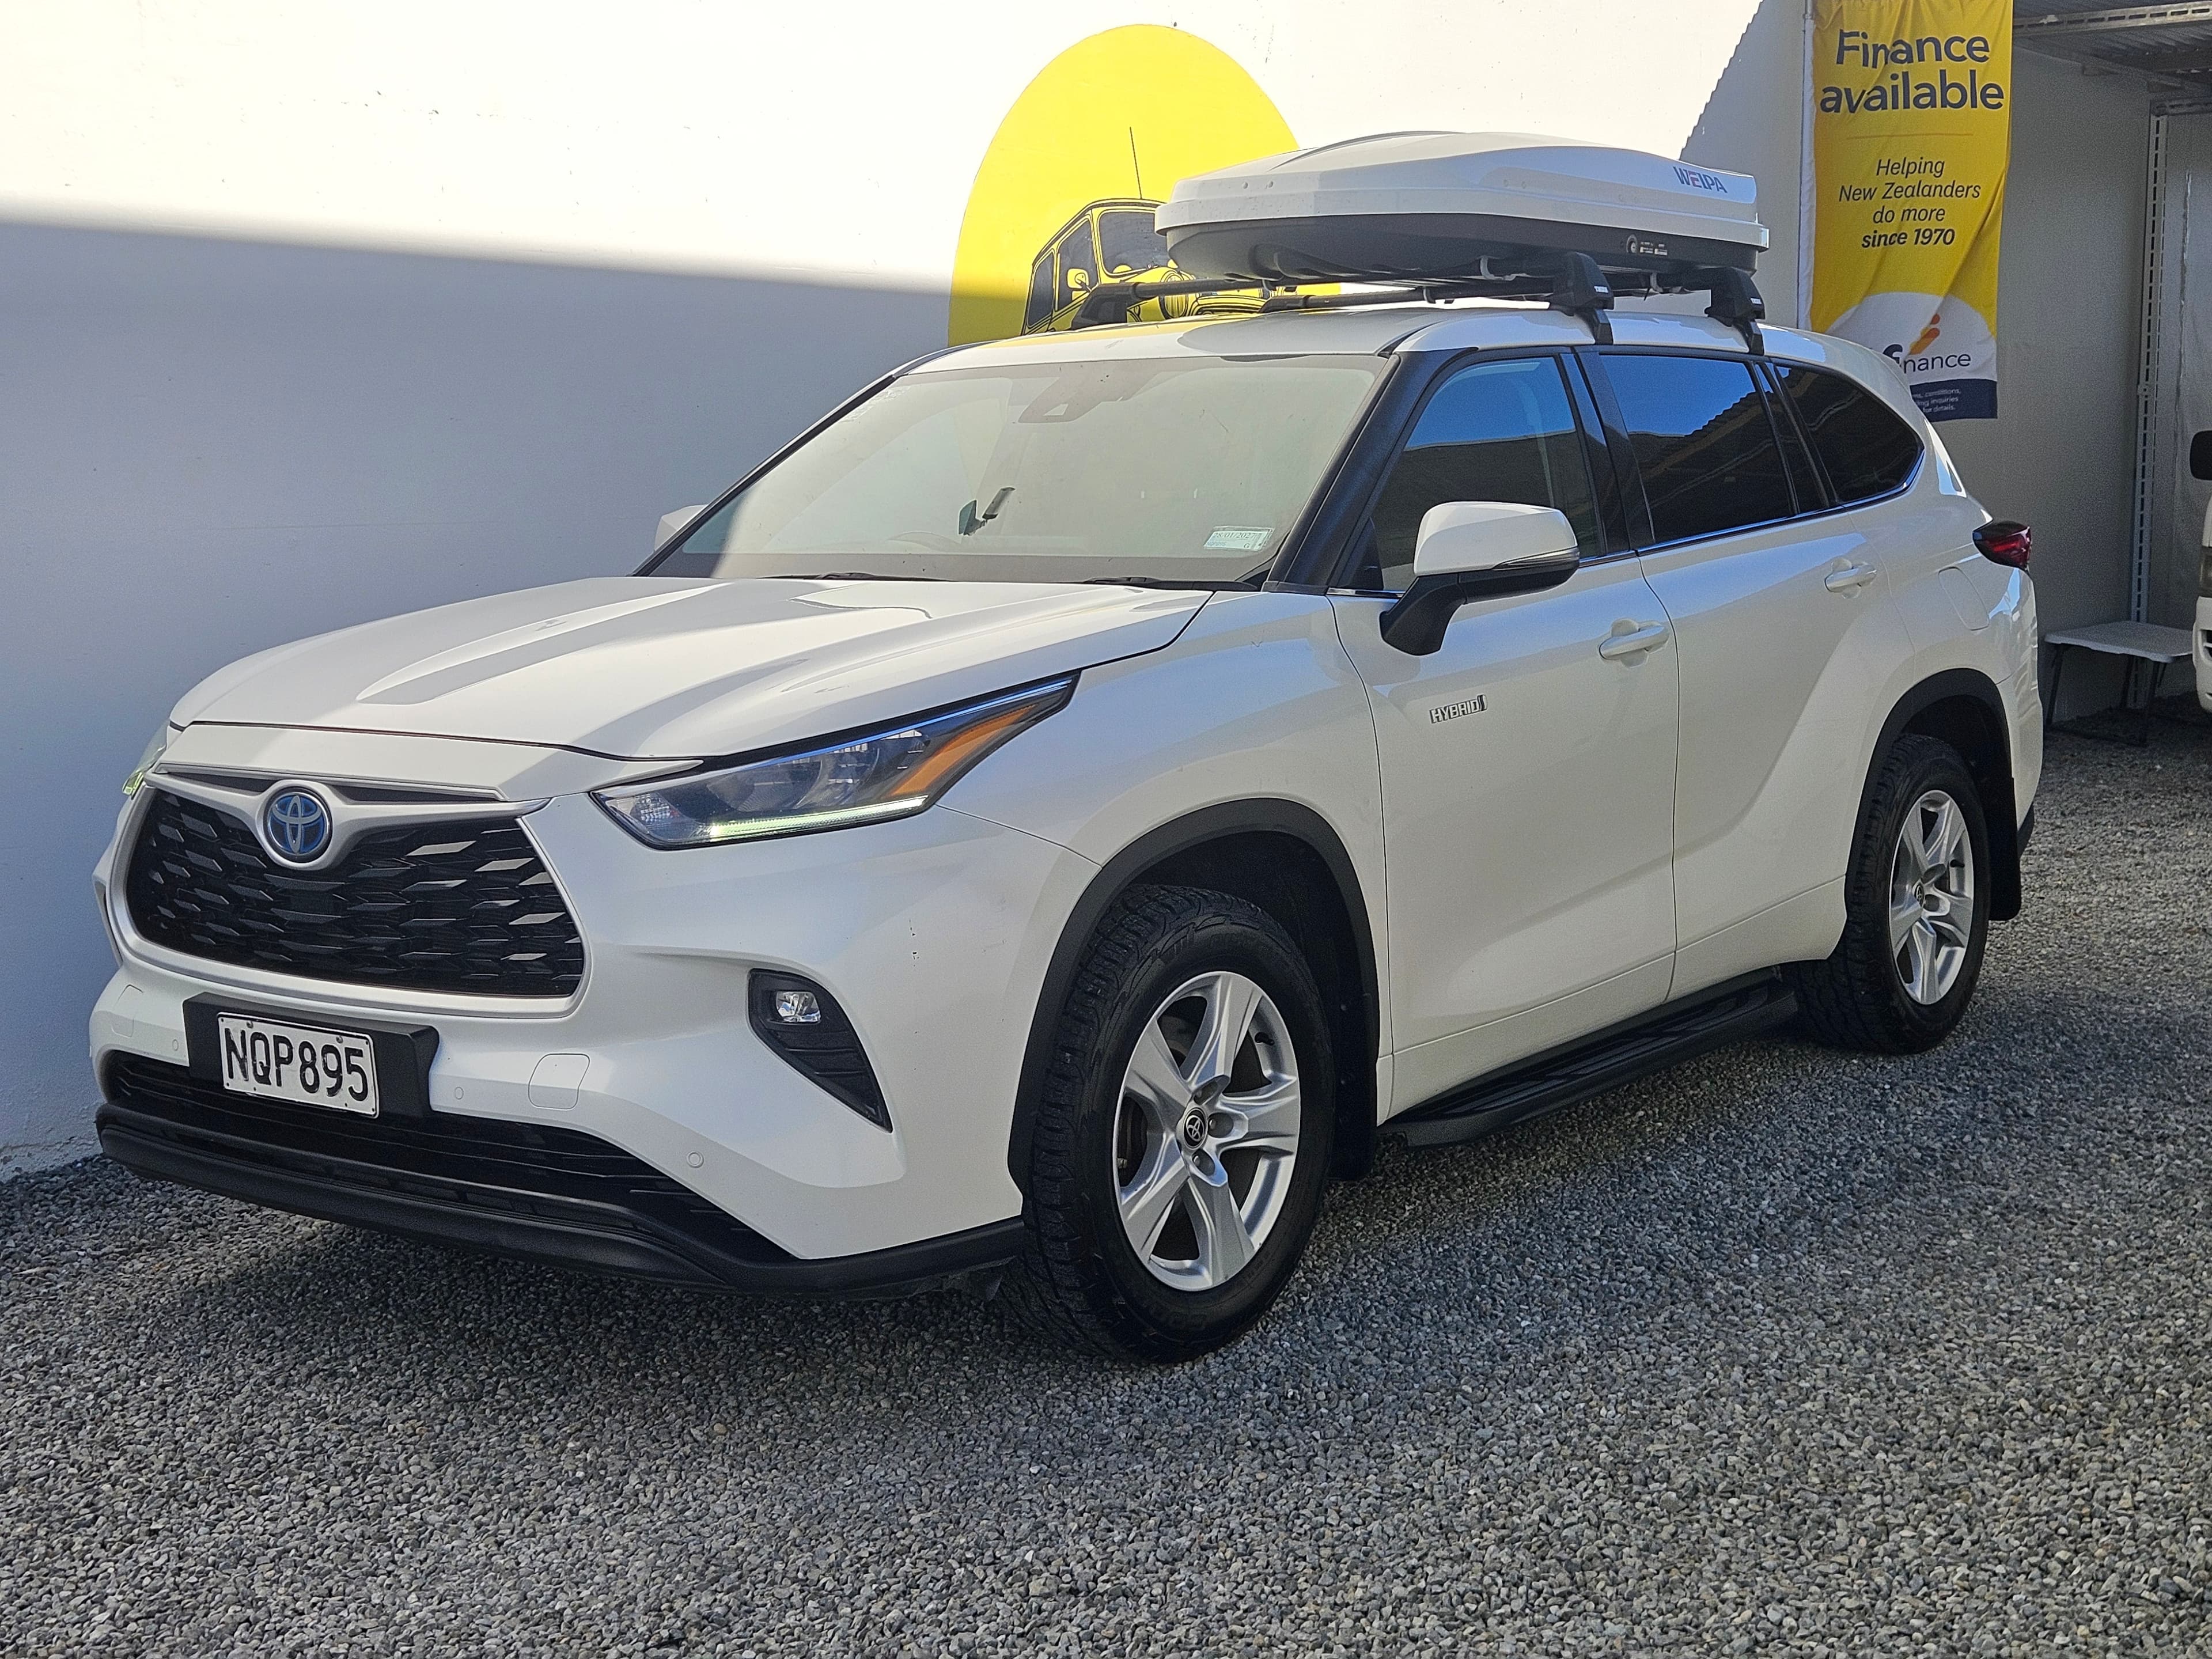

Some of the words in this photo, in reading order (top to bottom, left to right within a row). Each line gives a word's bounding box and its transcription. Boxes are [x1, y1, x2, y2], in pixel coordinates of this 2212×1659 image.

[1836, 29, 1990, 69] Finance
[1820, 69, 2005, 113] available
[1876, 157, 1945, 178] Helping
[1839, 185, 1877, 202] New
[1881, 180, 1982, 200] Zealanders
[1873, 206, 1895, 224] do
[1901, 207, 1945, 222] more
[1861, 230, 1907, 248] since
[1914, 228, 1955, 245] 1970
[1429, 698, 1481, 724] HYBRID
[224, 1028, 369, 1102] NQP895
